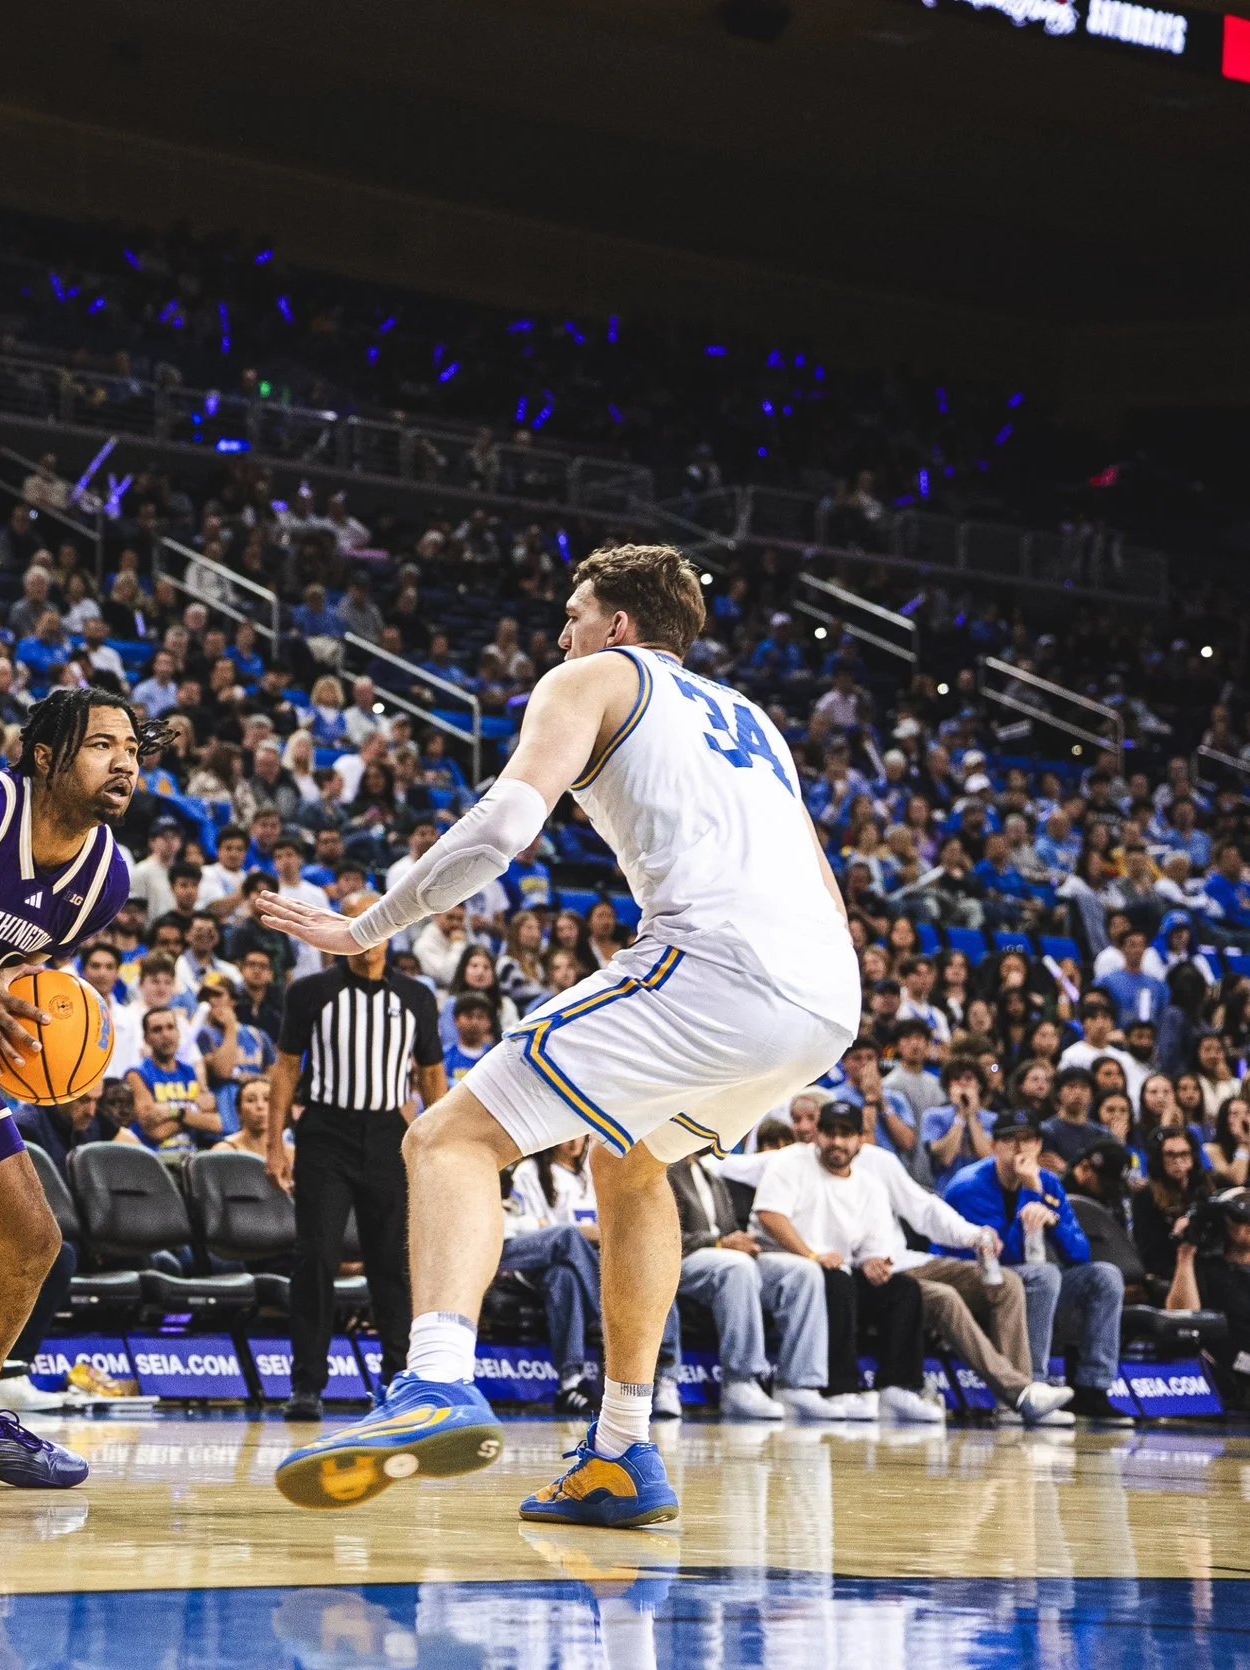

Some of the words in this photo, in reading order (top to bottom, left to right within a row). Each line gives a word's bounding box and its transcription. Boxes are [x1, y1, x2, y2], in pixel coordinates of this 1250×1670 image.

[669, 672, 796, 799] 34
[135, 1354, 240, 1376] SEIA.COM
[1130, 1375, 1211, 1398] SEIA.COM
